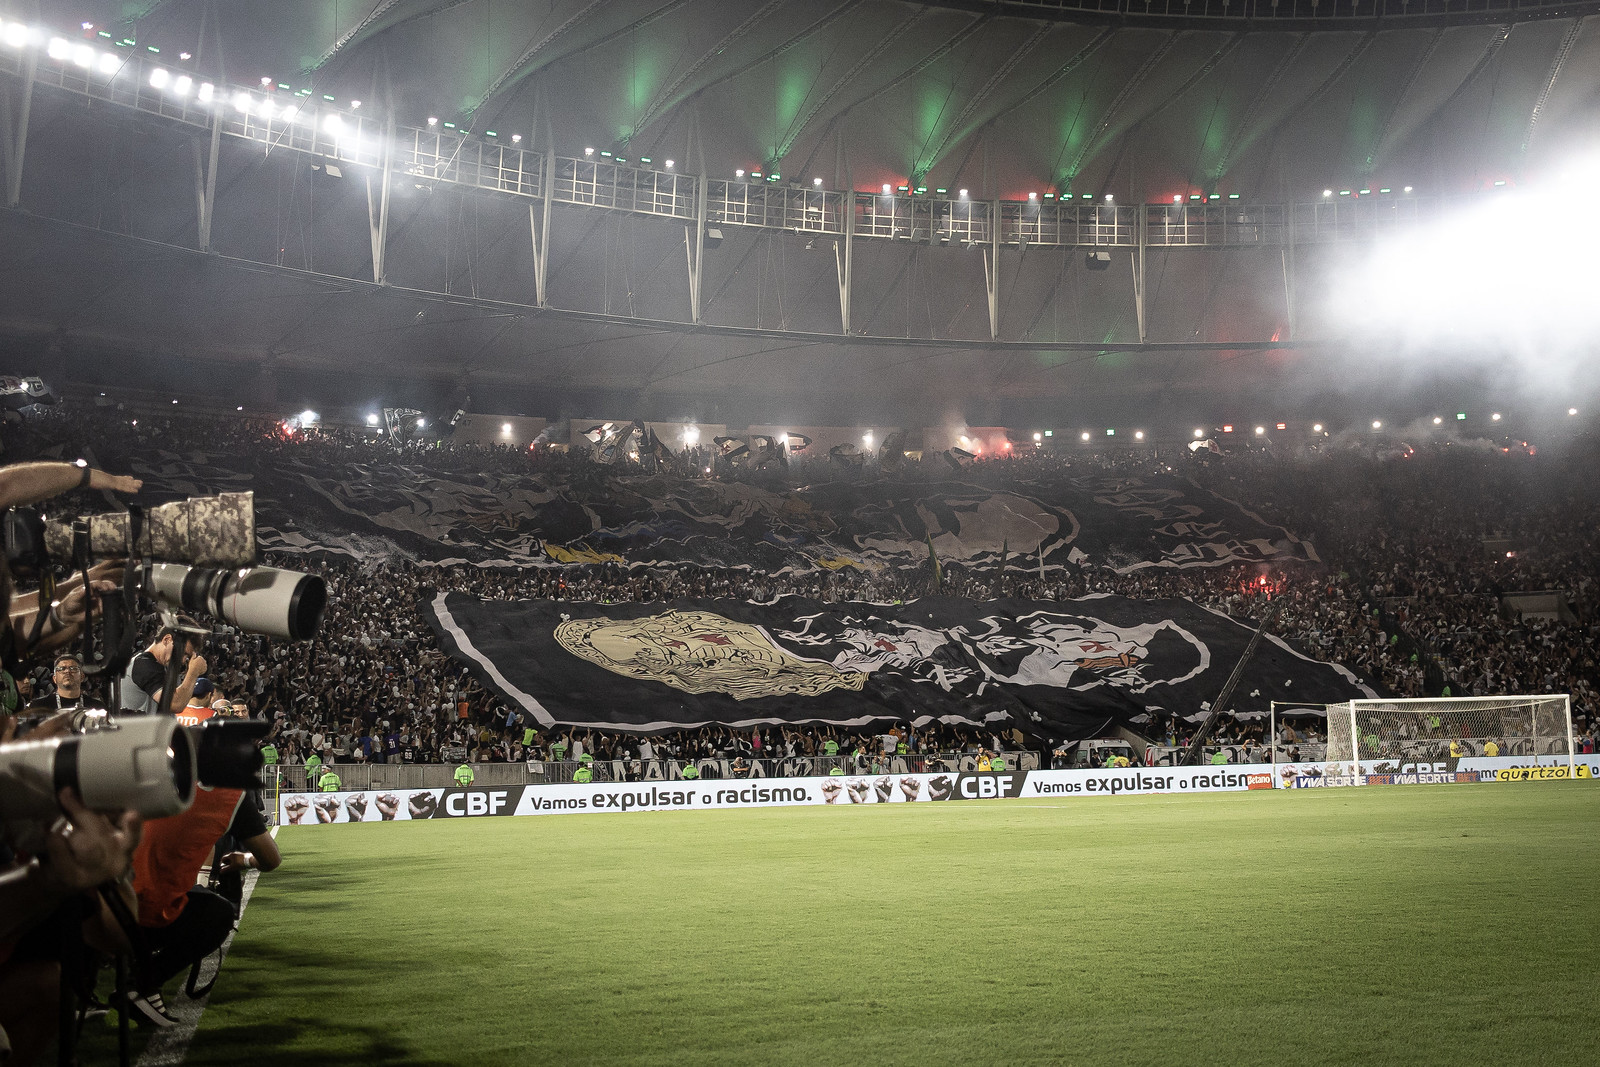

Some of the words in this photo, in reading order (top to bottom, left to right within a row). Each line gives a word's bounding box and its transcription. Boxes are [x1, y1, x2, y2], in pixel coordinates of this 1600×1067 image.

[388, 741, 396, 749] 31
[404, 752, 413, 760] 99
[1033, 781, 1081, 793] Vamos
[1086, 772, 1174, 794] expulsar
[1179, 779, 1188, 789] o
[1247, 775, 1271, 785] Betano
[1300, 777, 1326, 788] VIVA
[1369, 776, 1391, 785] BET
[1394, 774, 1417, 784] VIVA
[1419, 773, 1455, 783] SORTE
[961, 776, 1013, 798] CBF
[446, 791, 508, 816] CBF
[531, 796, 587, 810] Vamos
[592, 786, 696, 811] expulsar
[702, 794, 712, 805] o
[717, 784, 812, 804] racismo.
